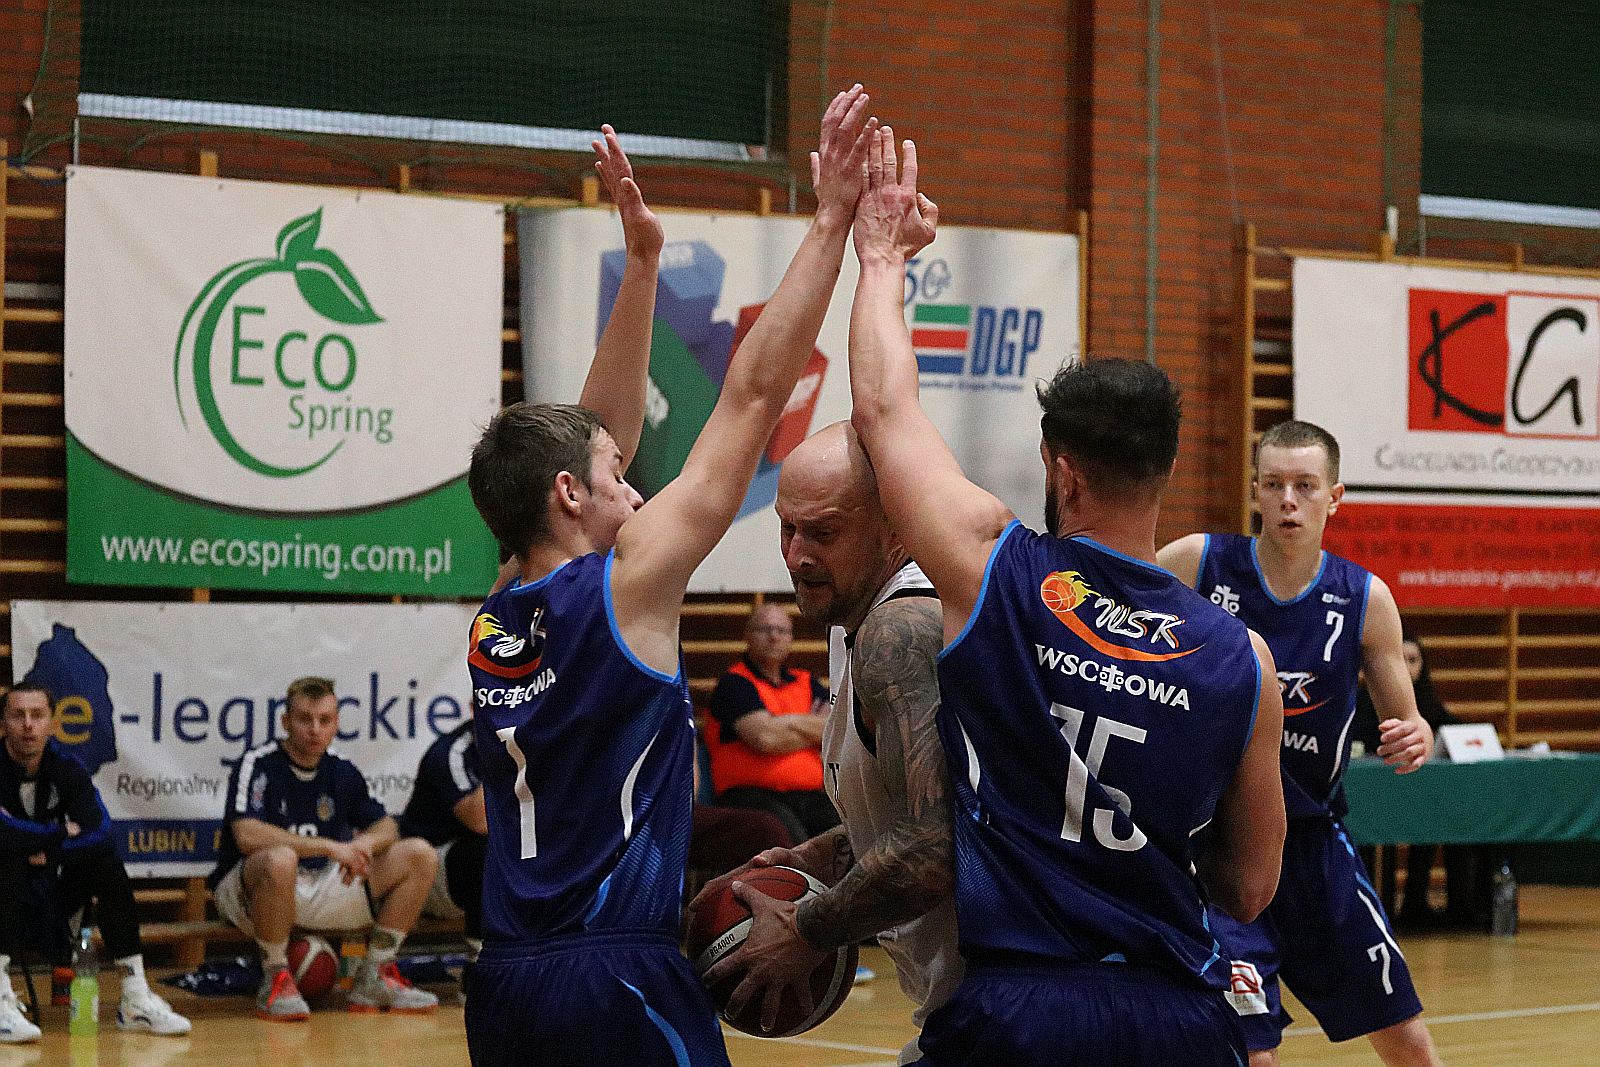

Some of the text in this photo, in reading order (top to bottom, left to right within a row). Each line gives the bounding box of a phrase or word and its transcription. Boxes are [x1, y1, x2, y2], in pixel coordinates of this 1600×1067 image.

[971, 305, 1043, 377] DGP
[288, 395, 393, 443] Spring
[101, 533, 452, 582] www.ecospring.com.pl
[1094, 596, 1186, 649] WSK
[1323, 610, 1344, 662] 7
[1049, 701, 1148, 852] 15
[128, 830, 196, 853] LUBIN
[1366, 942, 1394, 995] 7
